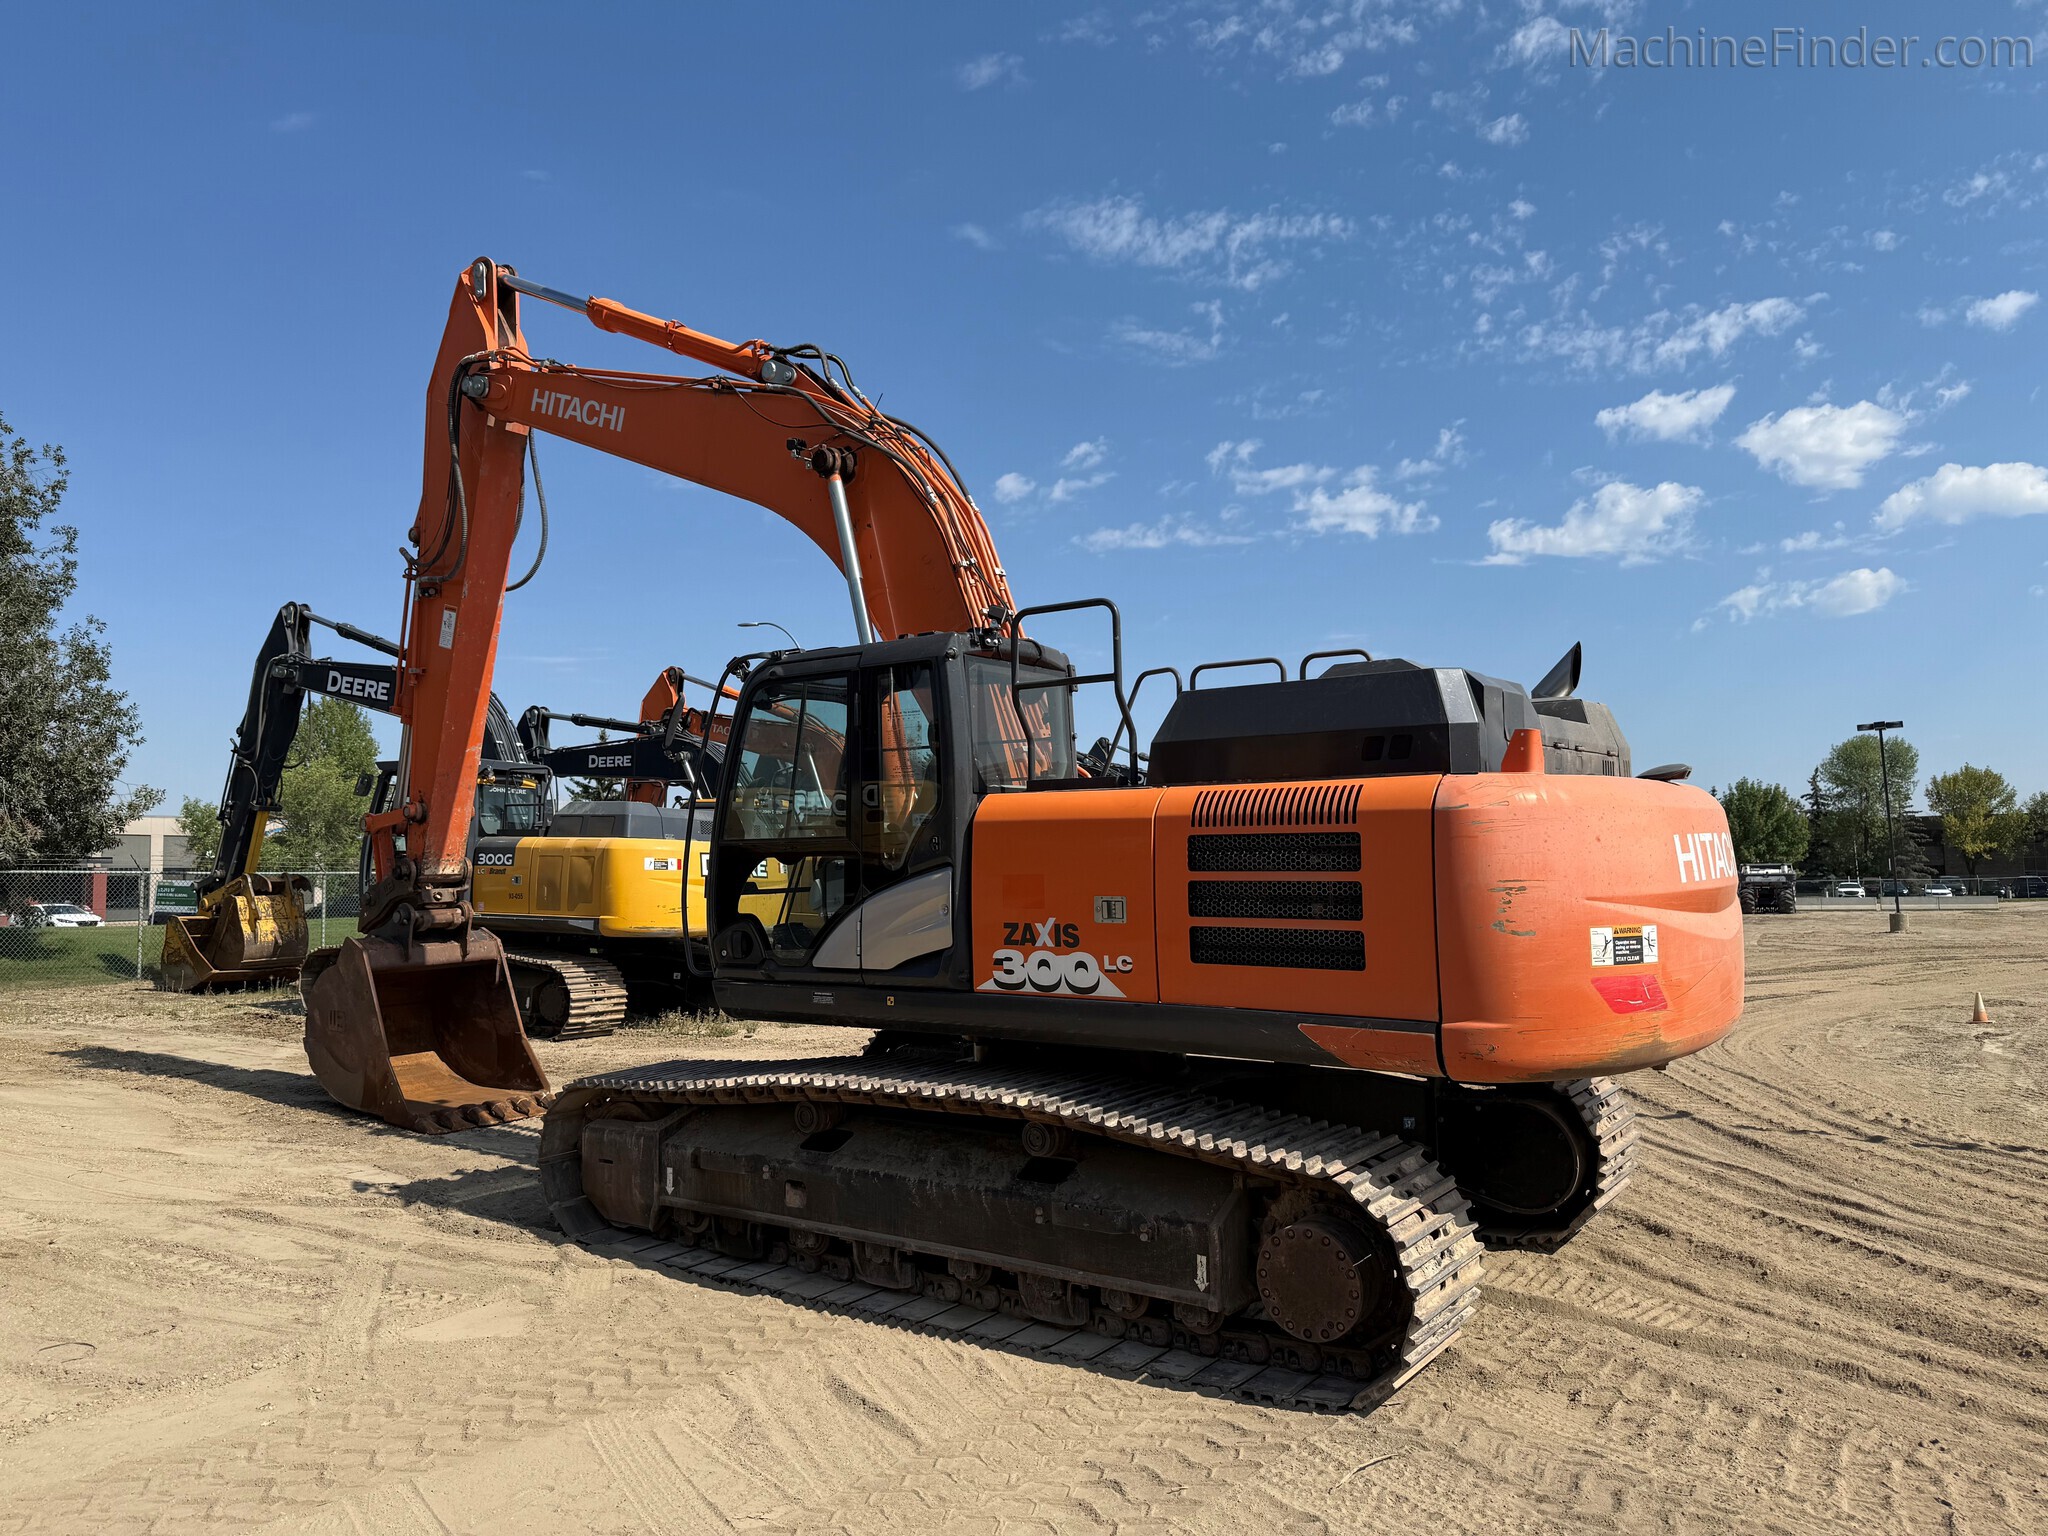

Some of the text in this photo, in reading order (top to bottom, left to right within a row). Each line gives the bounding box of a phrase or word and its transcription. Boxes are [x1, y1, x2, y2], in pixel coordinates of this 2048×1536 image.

[531, 388, 626, 433] HITACHI
[326, 670, 391, 701] DEERE
[588, 754, 632, 769] DEERE
[477, 853, 513, 866] 300G
[1003, 917, 1080, 948] ZAXIS
[992, 949, 1133, 994] 300 LC
